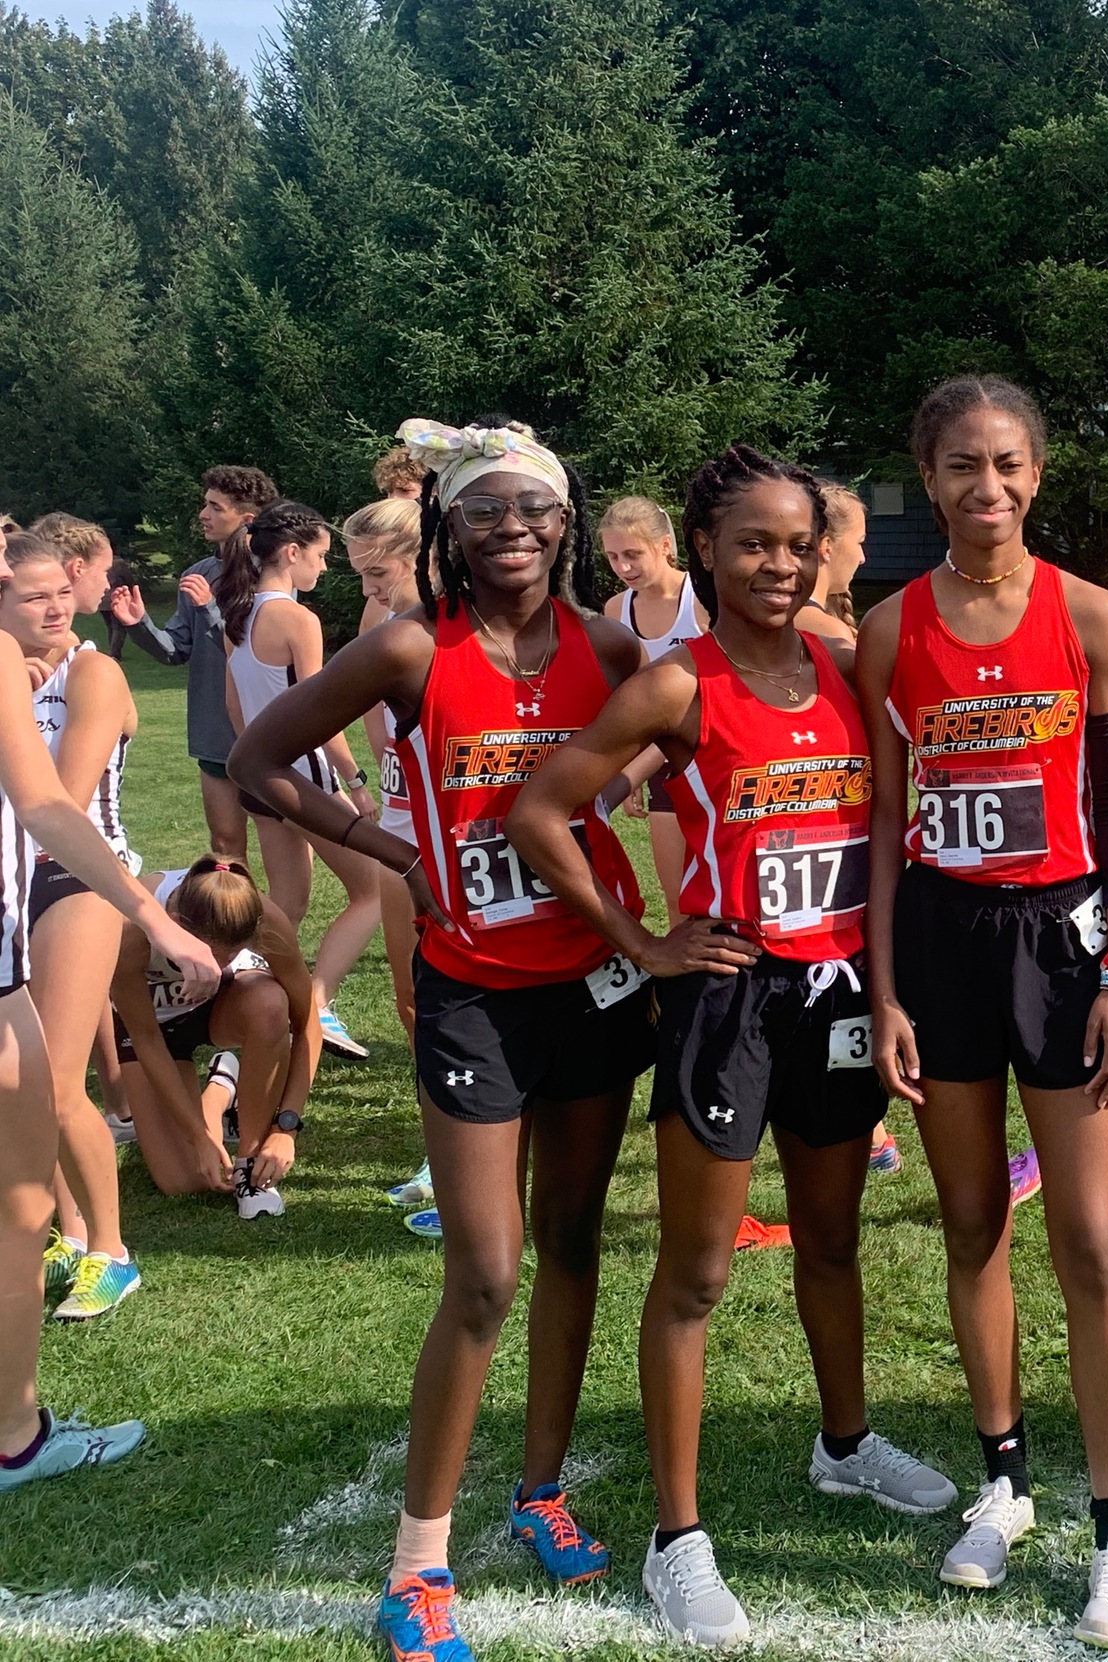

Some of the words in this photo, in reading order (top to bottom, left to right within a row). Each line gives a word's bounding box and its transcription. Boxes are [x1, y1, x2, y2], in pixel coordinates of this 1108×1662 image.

[945, 697, 1019, 714] UNIVERSITY
[1020, 696, 1034, 706] OF
[1036, 695, 1055, 705] THE
[917, 691, 1080, 745] FIREBIRDS
[483, 732, 556, 745] UNIVERSITY
[918, 741, 958, 757] DISTRICT
[957, 741, 970, 751] OF
[970, 737, 1025, 751] COLUMBIA
[381, 752, 400, 793] 86
[769, 759, 836, 776] UNIVERSITY
[837, 759, 849, 769] OF
[850, 759, 864, 769] THE
[444, 774, 493, 788] DISTRICT
[491, 774, 505, 784] OF
[727, 805, 777, 821] DISTRICT
[774, 802, 787, 812] OF
[787, 798, 838, 812] COLUMBIA
[920, 793, 1005, 850] 316
[759, 851, 842, 917] 317
